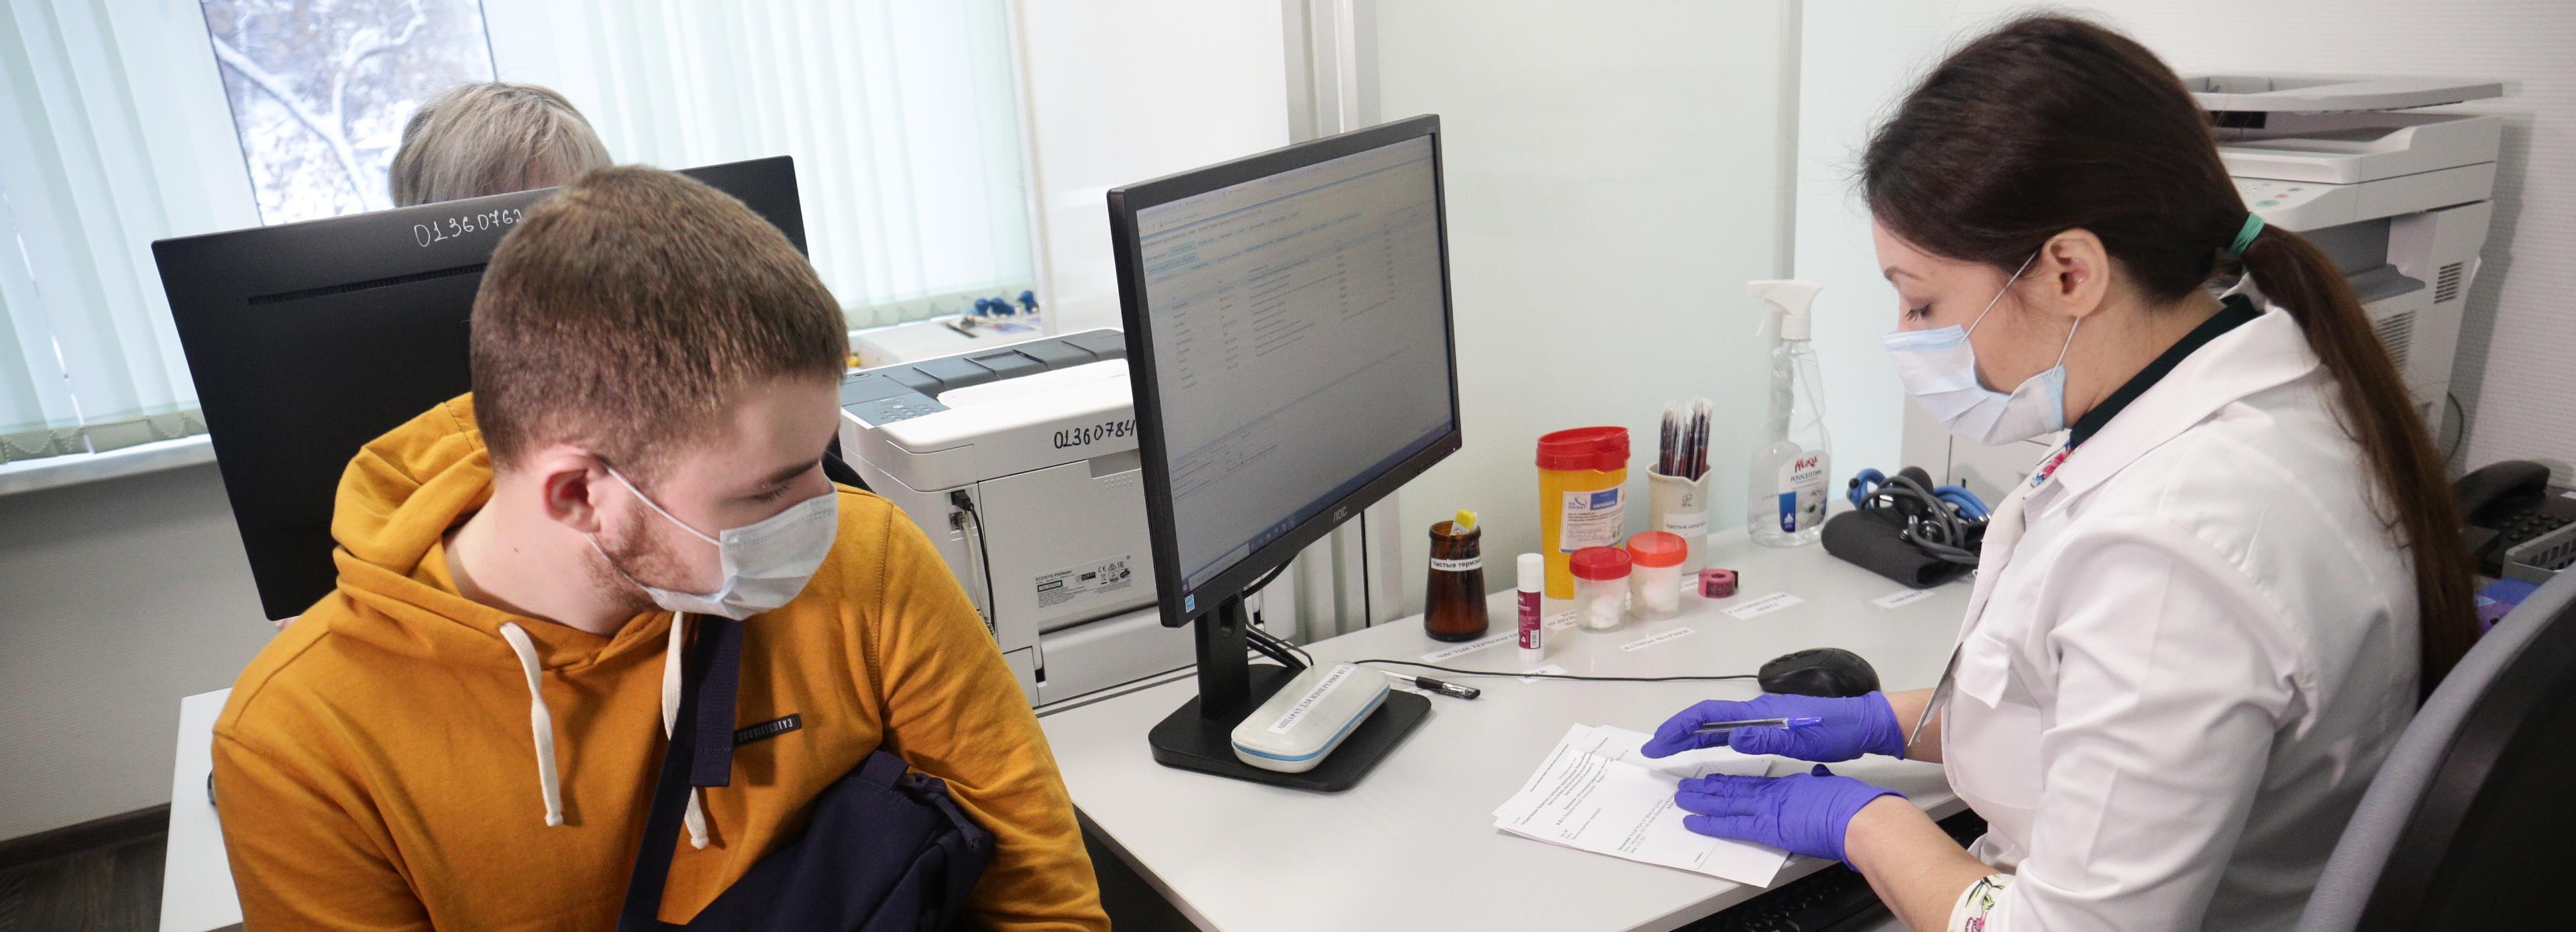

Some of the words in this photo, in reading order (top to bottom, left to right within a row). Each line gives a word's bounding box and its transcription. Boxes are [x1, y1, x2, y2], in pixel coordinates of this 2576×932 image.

[1053, 419, 1136, 449] 01360784
[1333, 506, 1347, 523] AOC
[1432, 559, 1456, 568] Чистые
